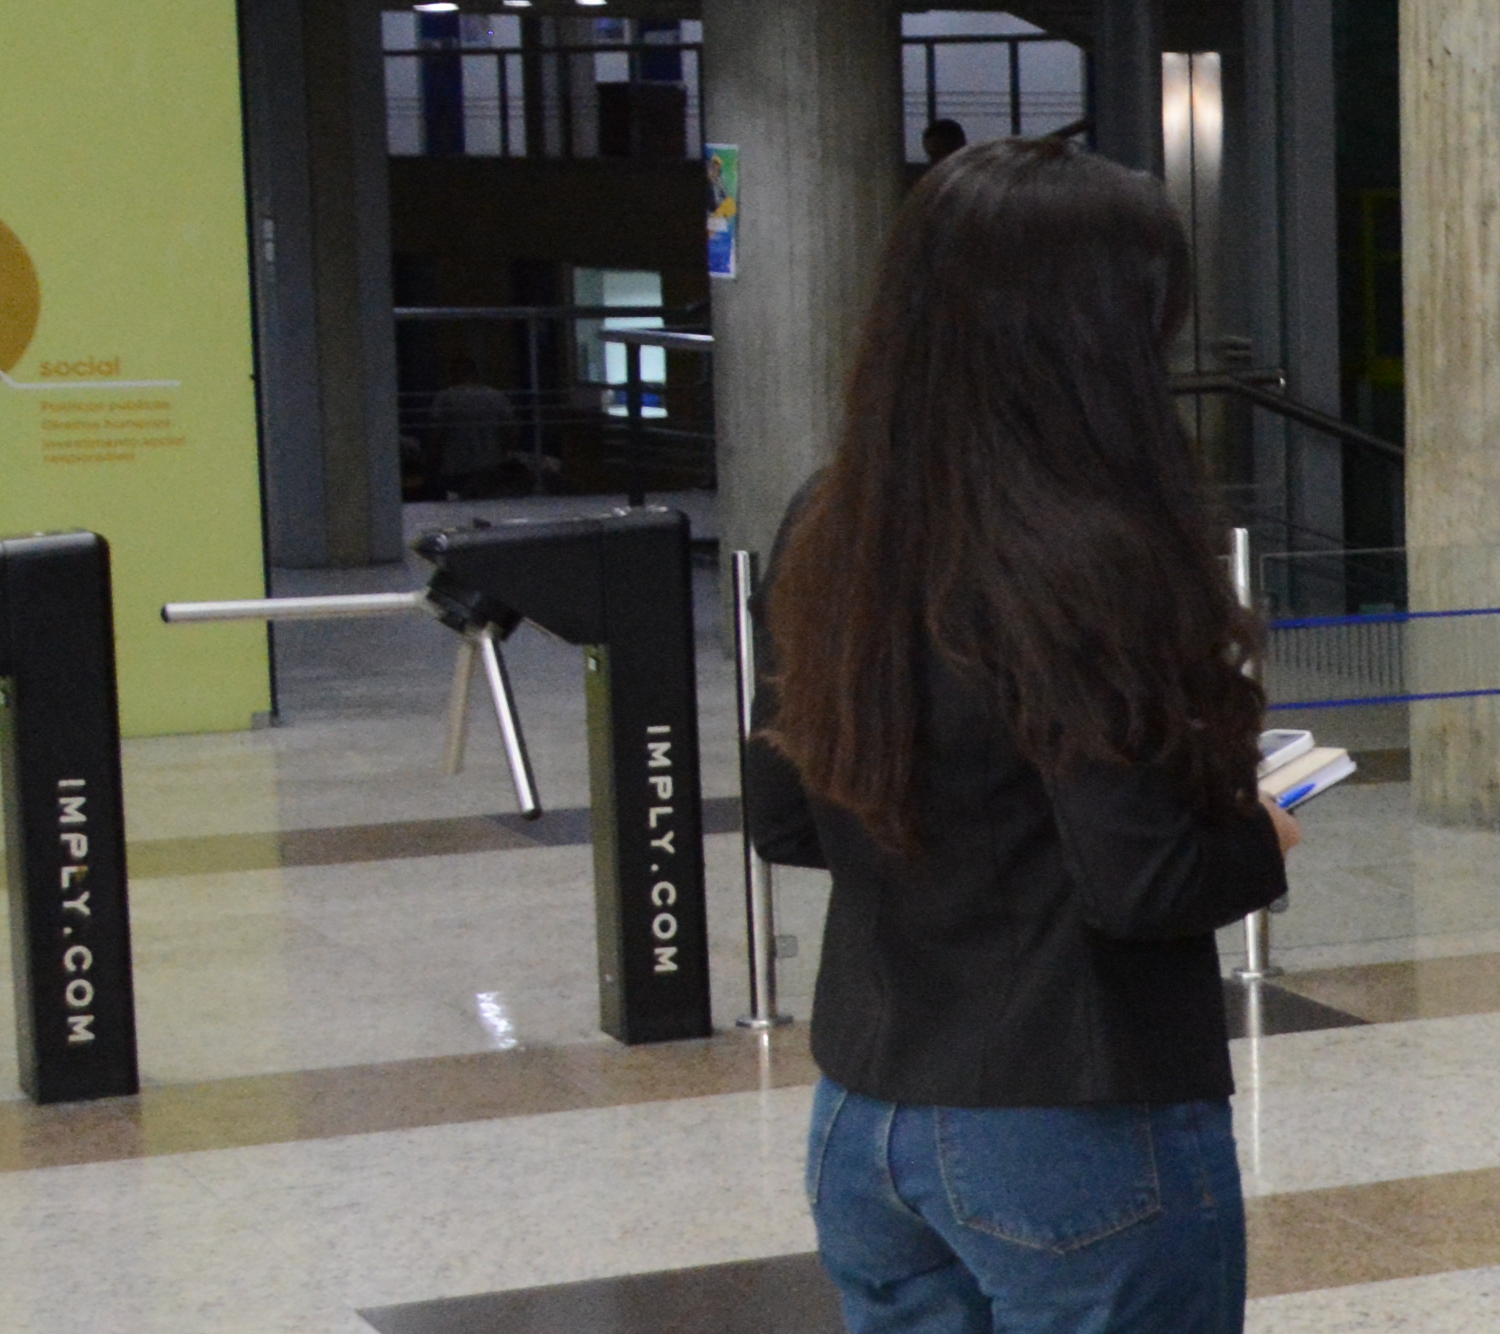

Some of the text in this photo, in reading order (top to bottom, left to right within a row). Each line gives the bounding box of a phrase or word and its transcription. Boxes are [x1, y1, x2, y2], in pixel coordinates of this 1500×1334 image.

[40, 356, 121, 377] social
[57, 778, 96, 1044] IMPLY.COM
[647, 725, 678, 972] IMPLY.COM
